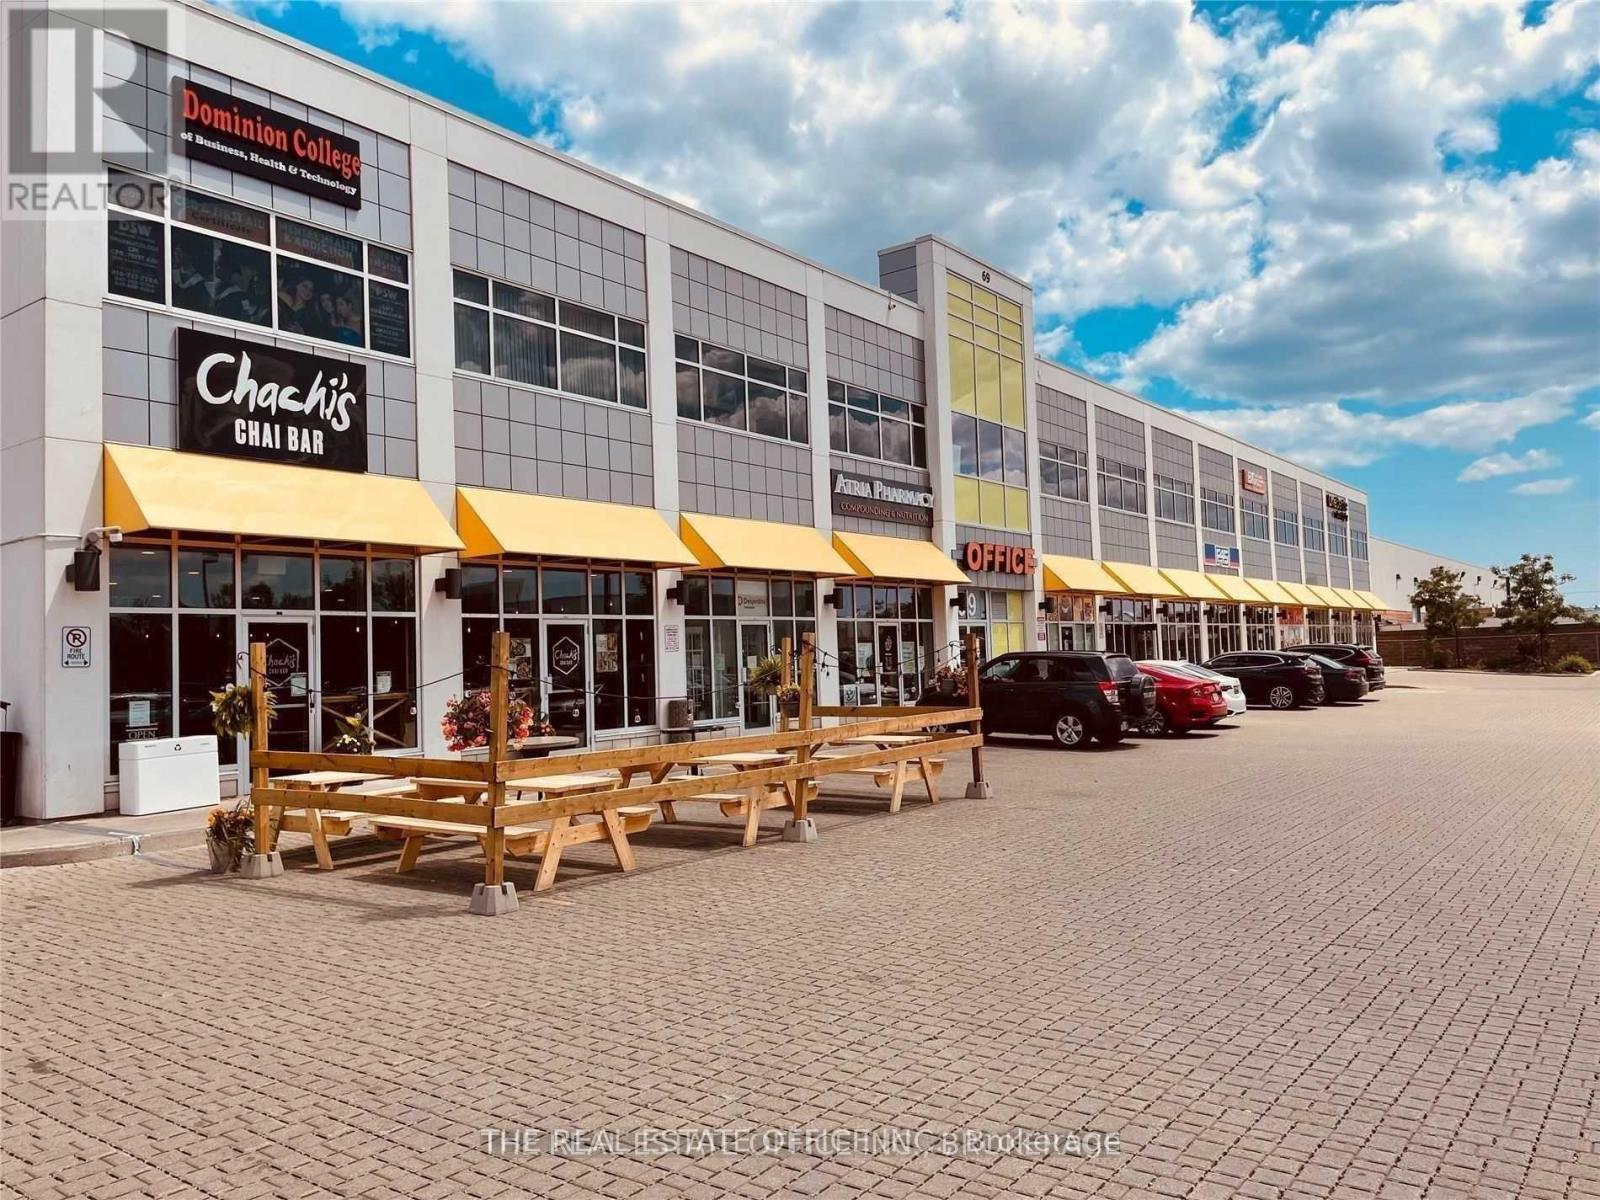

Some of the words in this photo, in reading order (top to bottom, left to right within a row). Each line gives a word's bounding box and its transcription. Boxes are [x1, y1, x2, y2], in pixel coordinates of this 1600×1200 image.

[183, 87, 288, 152] Dominion
[293, 127, 362, 180] College
[180, 130, 194, 141] of
[194, 133, 249, 162] Business,
[250, 151, 287, 172] Health
[287, 164, 299, 175] &
[299, 167, 358, 196] Technology
[981, 270, 991, 283] 69
[196, 350, 357, 432] Chachi's
[234, 418, 281, 450] CHAI
[287, 425, 325, 455] BAR
[967, 540, 1035, 576] OFFICE
[128, 730, 157, 740] OPEN
